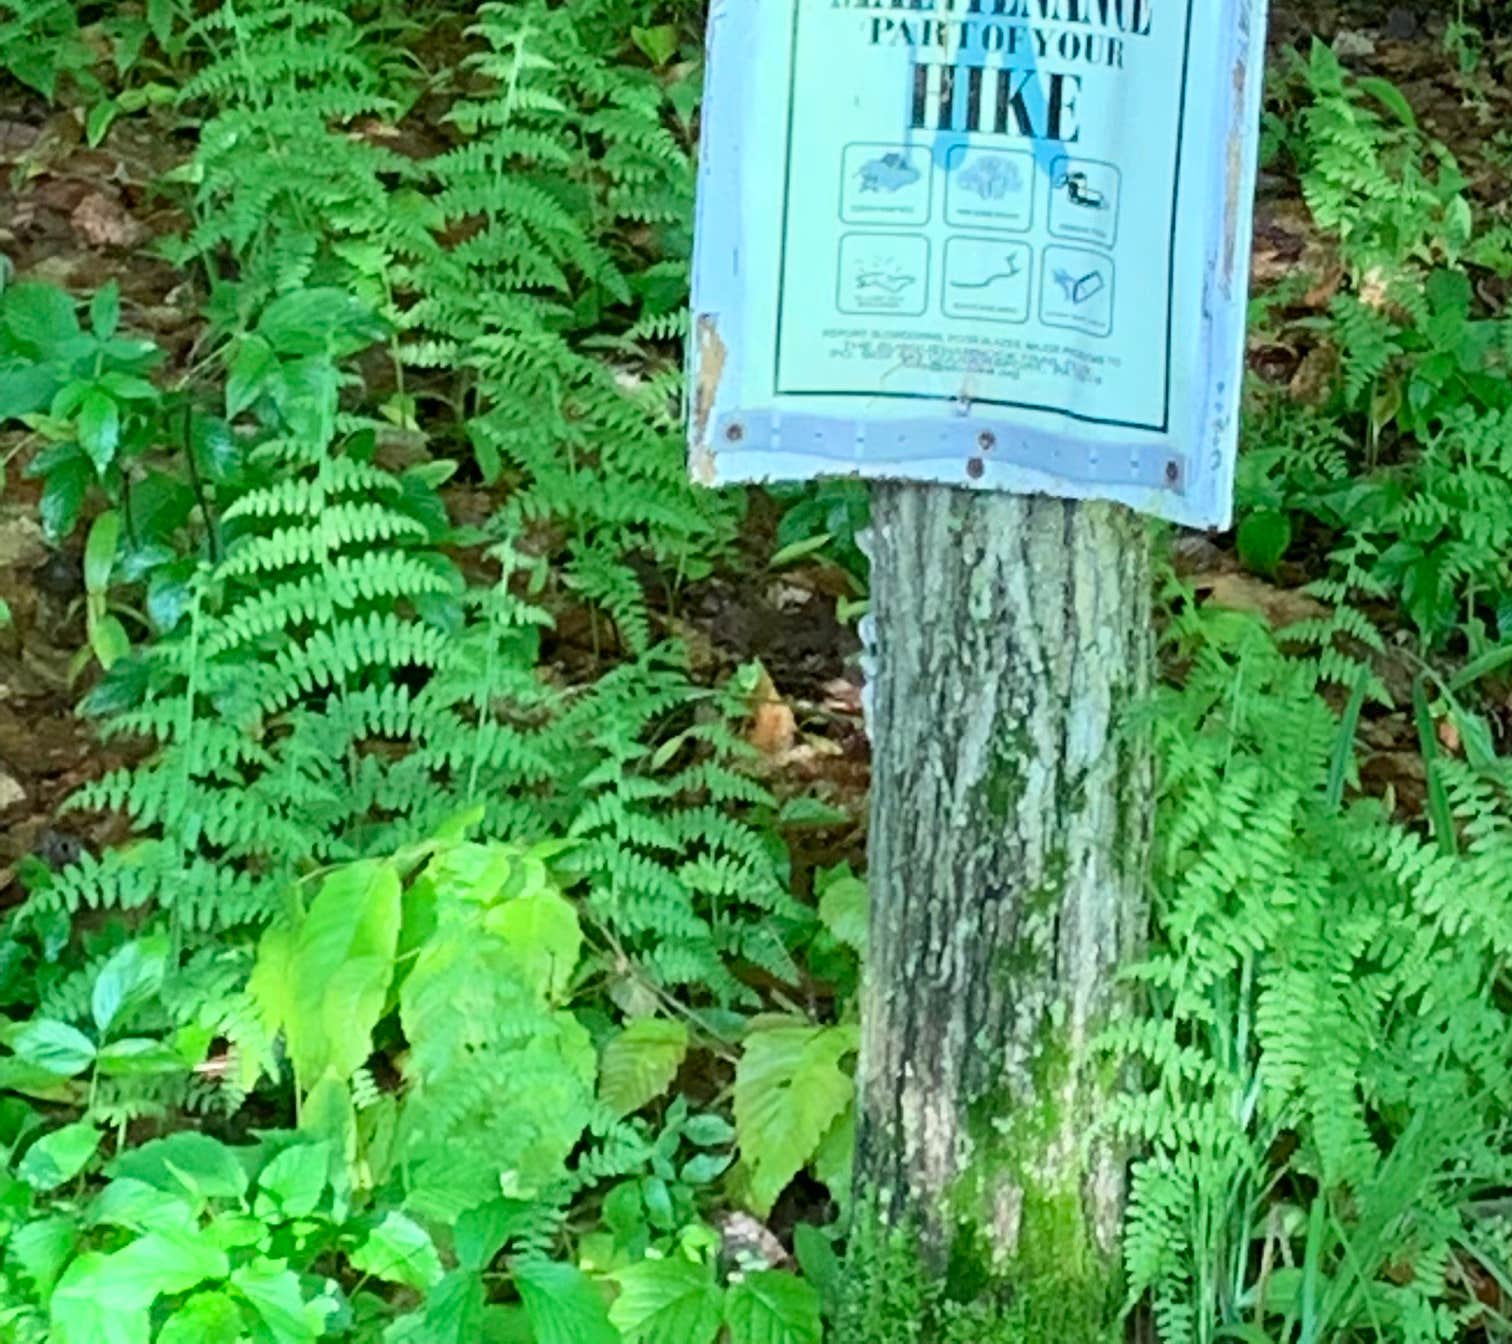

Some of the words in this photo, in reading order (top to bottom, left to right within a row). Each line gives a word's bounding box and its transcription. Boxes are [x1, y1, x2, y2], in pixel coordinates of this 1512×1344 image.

[869, 15, 976, 50] PART
[981, 22, 1030, 55] OF
[1032, 27, 1125, 69] YOUR
[909, 62, 1083, 144] HIKE
